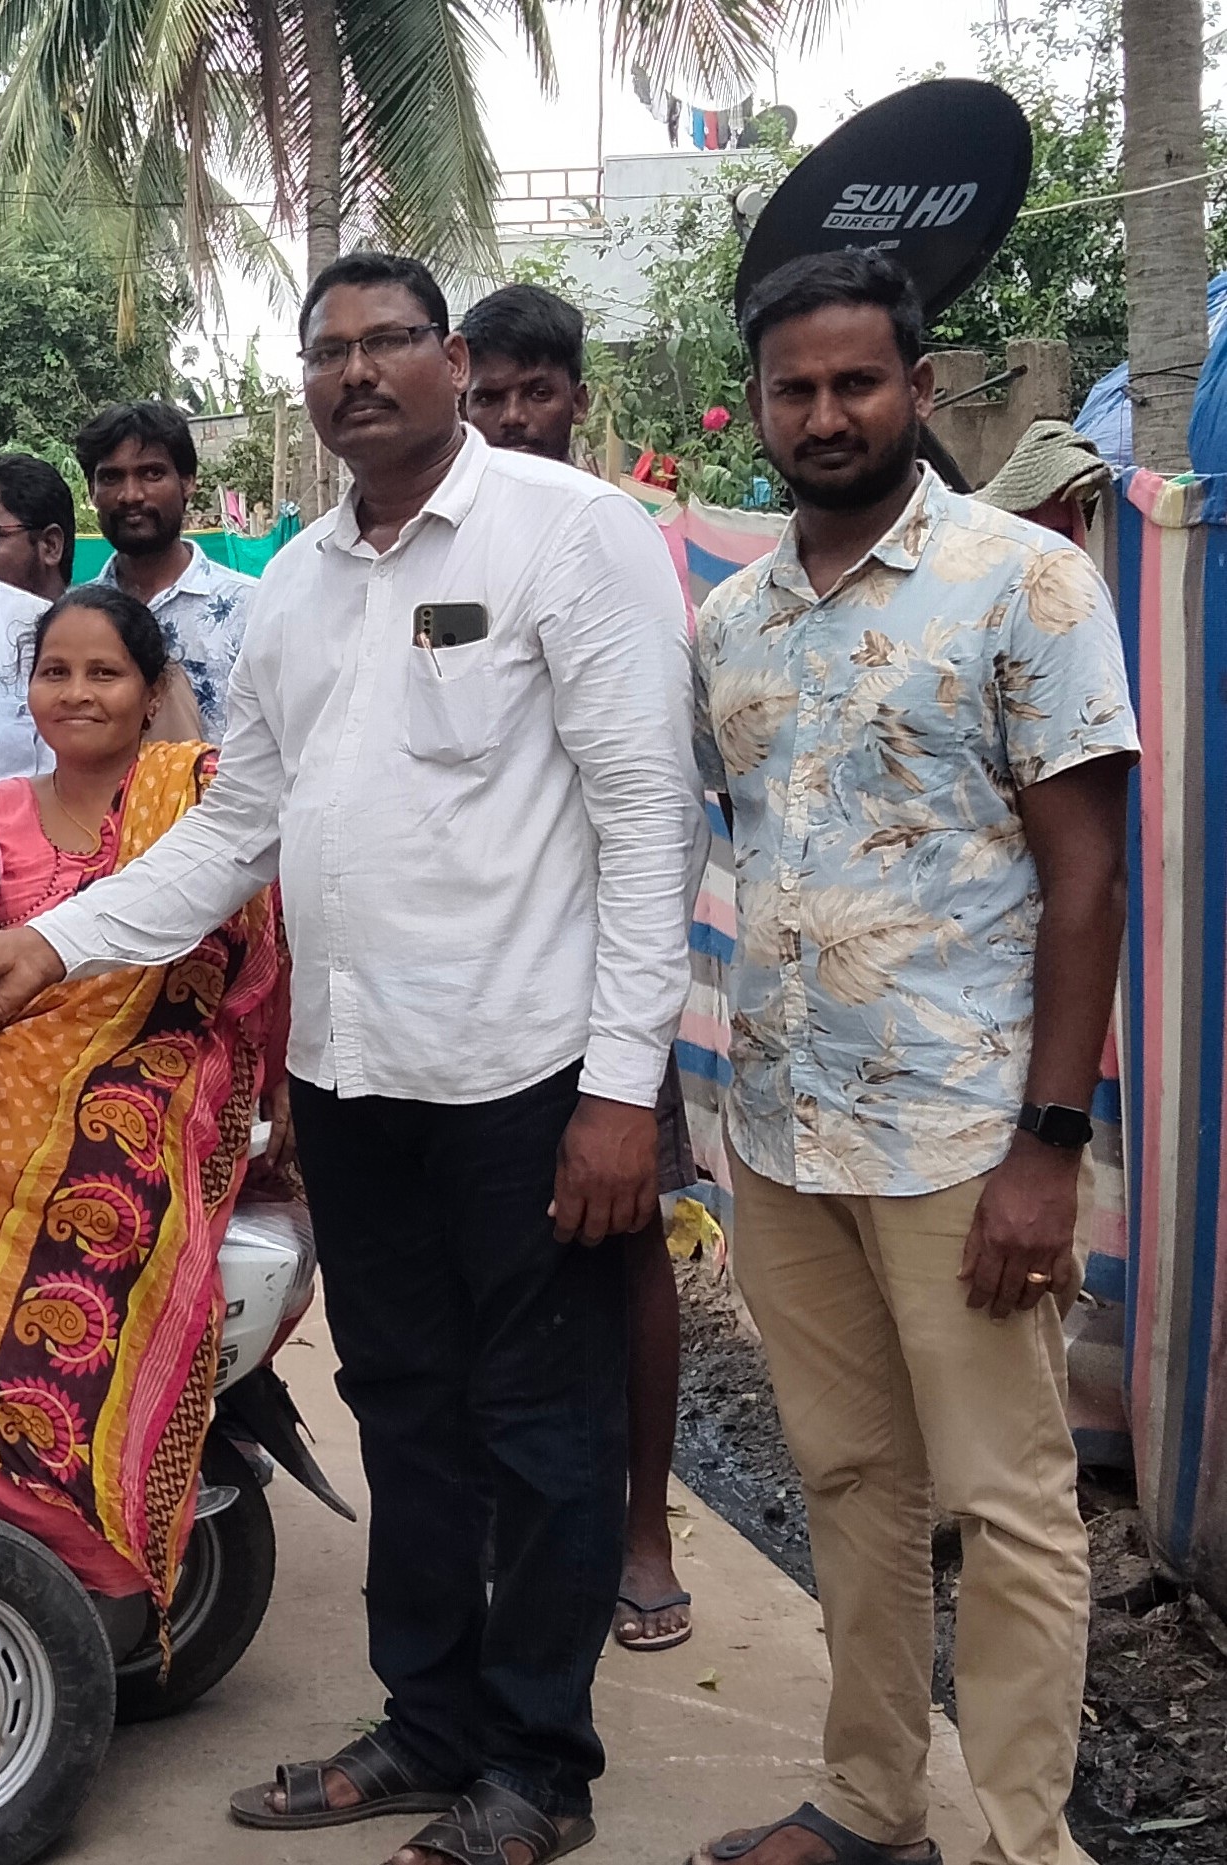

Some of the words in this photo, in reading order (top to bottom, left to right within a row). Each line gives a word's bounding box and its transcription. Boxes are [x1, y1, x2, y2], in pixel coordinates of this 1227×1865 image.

[833, 184, 919, 212] SUN
[903, 182, 978, 229] HD
[828, 216, 894, 228] DIRECT
